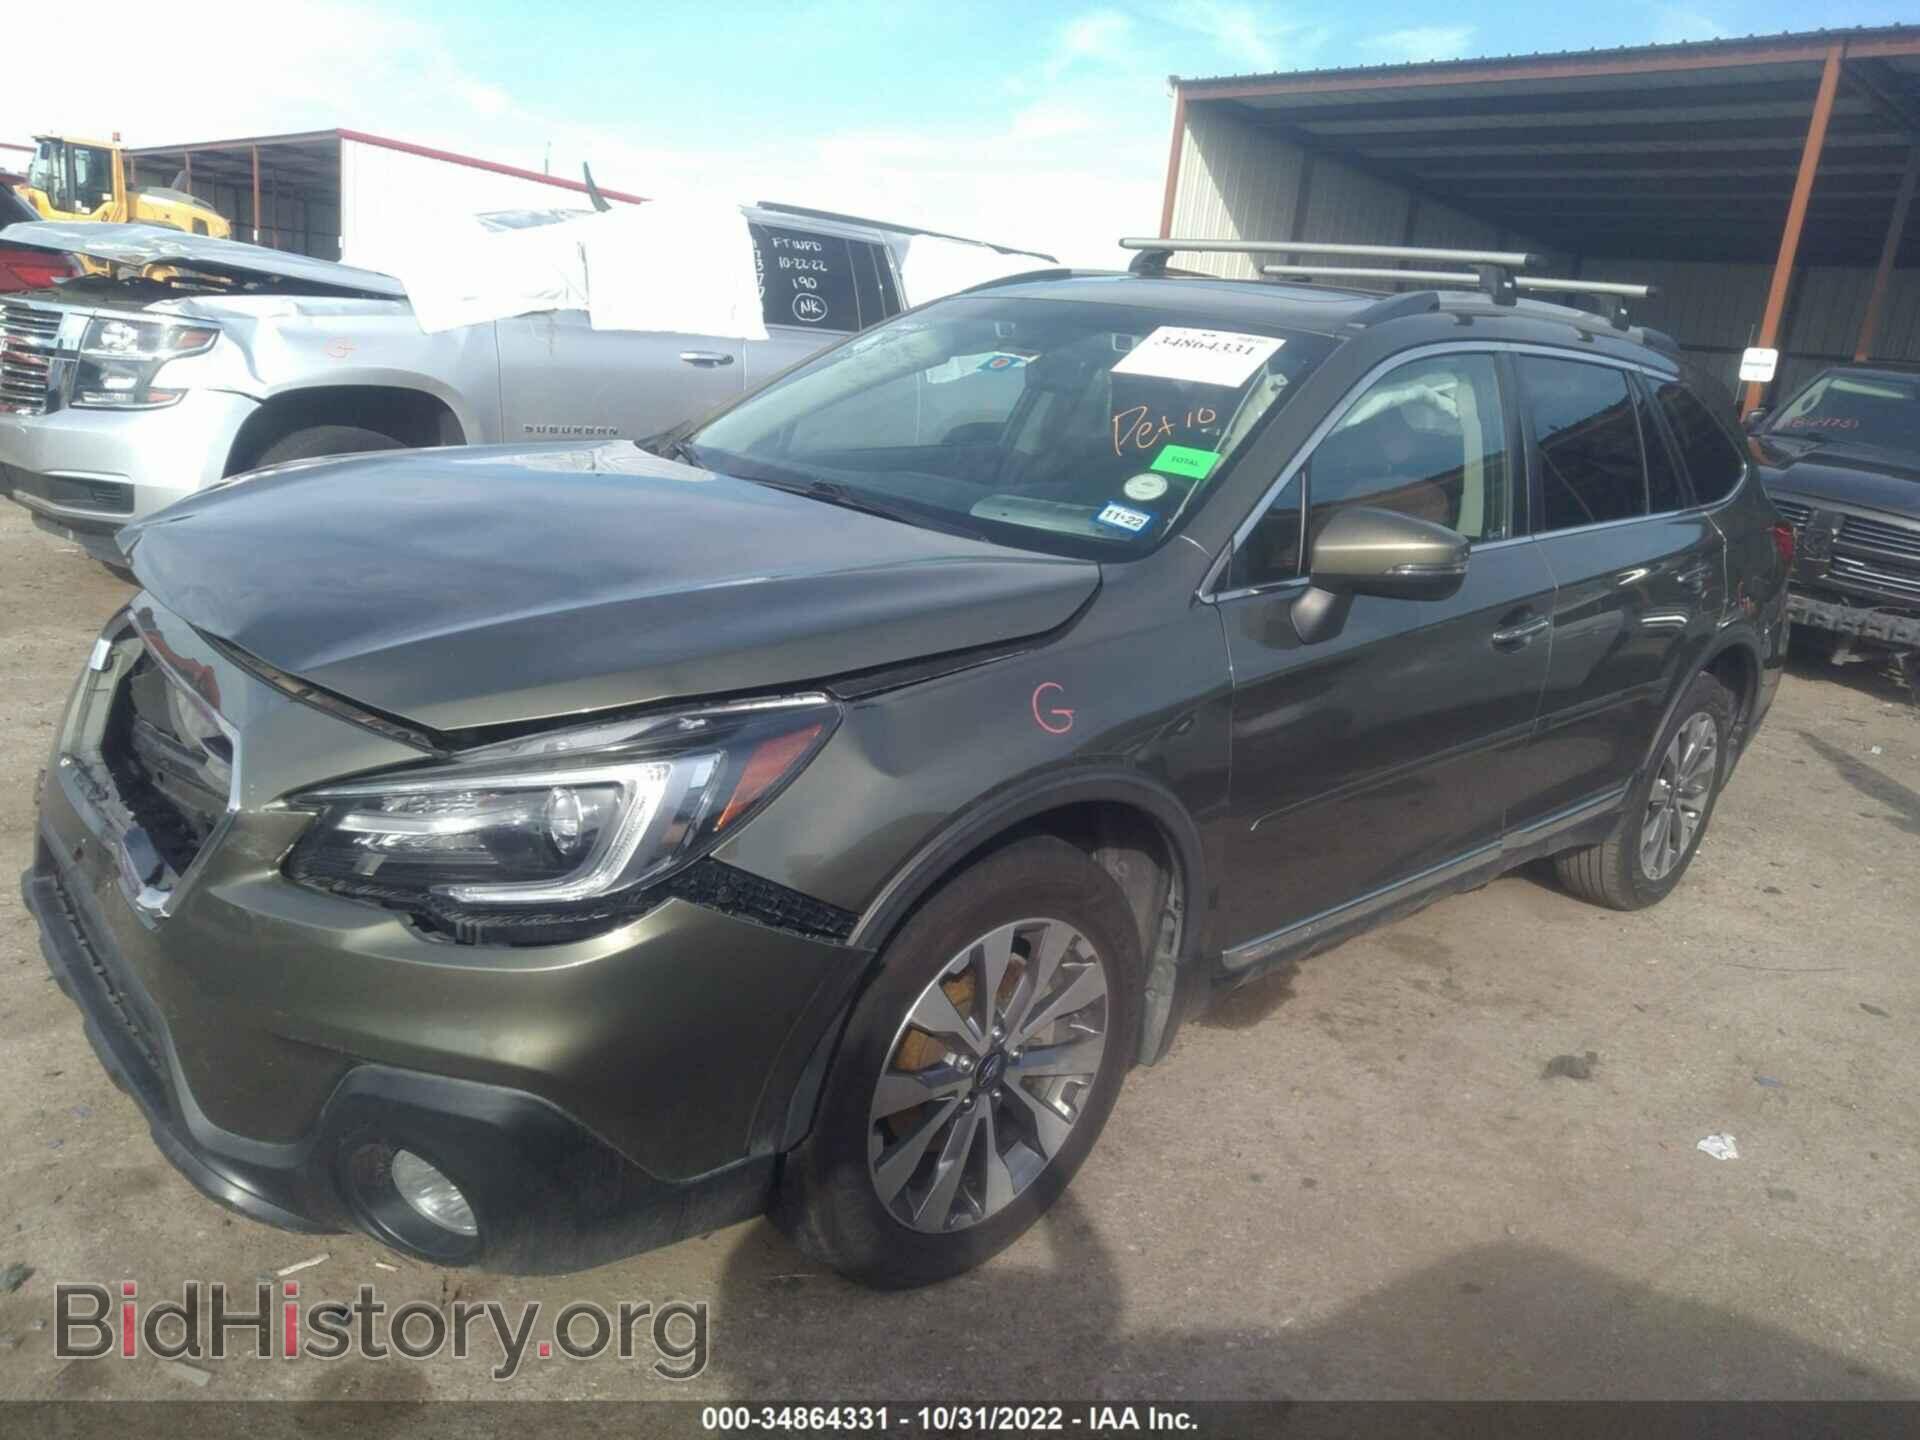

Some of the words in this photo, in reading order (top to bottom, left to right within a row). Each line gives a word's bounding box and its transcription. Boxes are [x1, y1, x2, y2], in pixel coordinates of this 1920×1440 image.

[791, 276, 818, 289] 190
[522, 423, 620, 436] SUBURBAN
[1032, 681, 1075, 734] G
